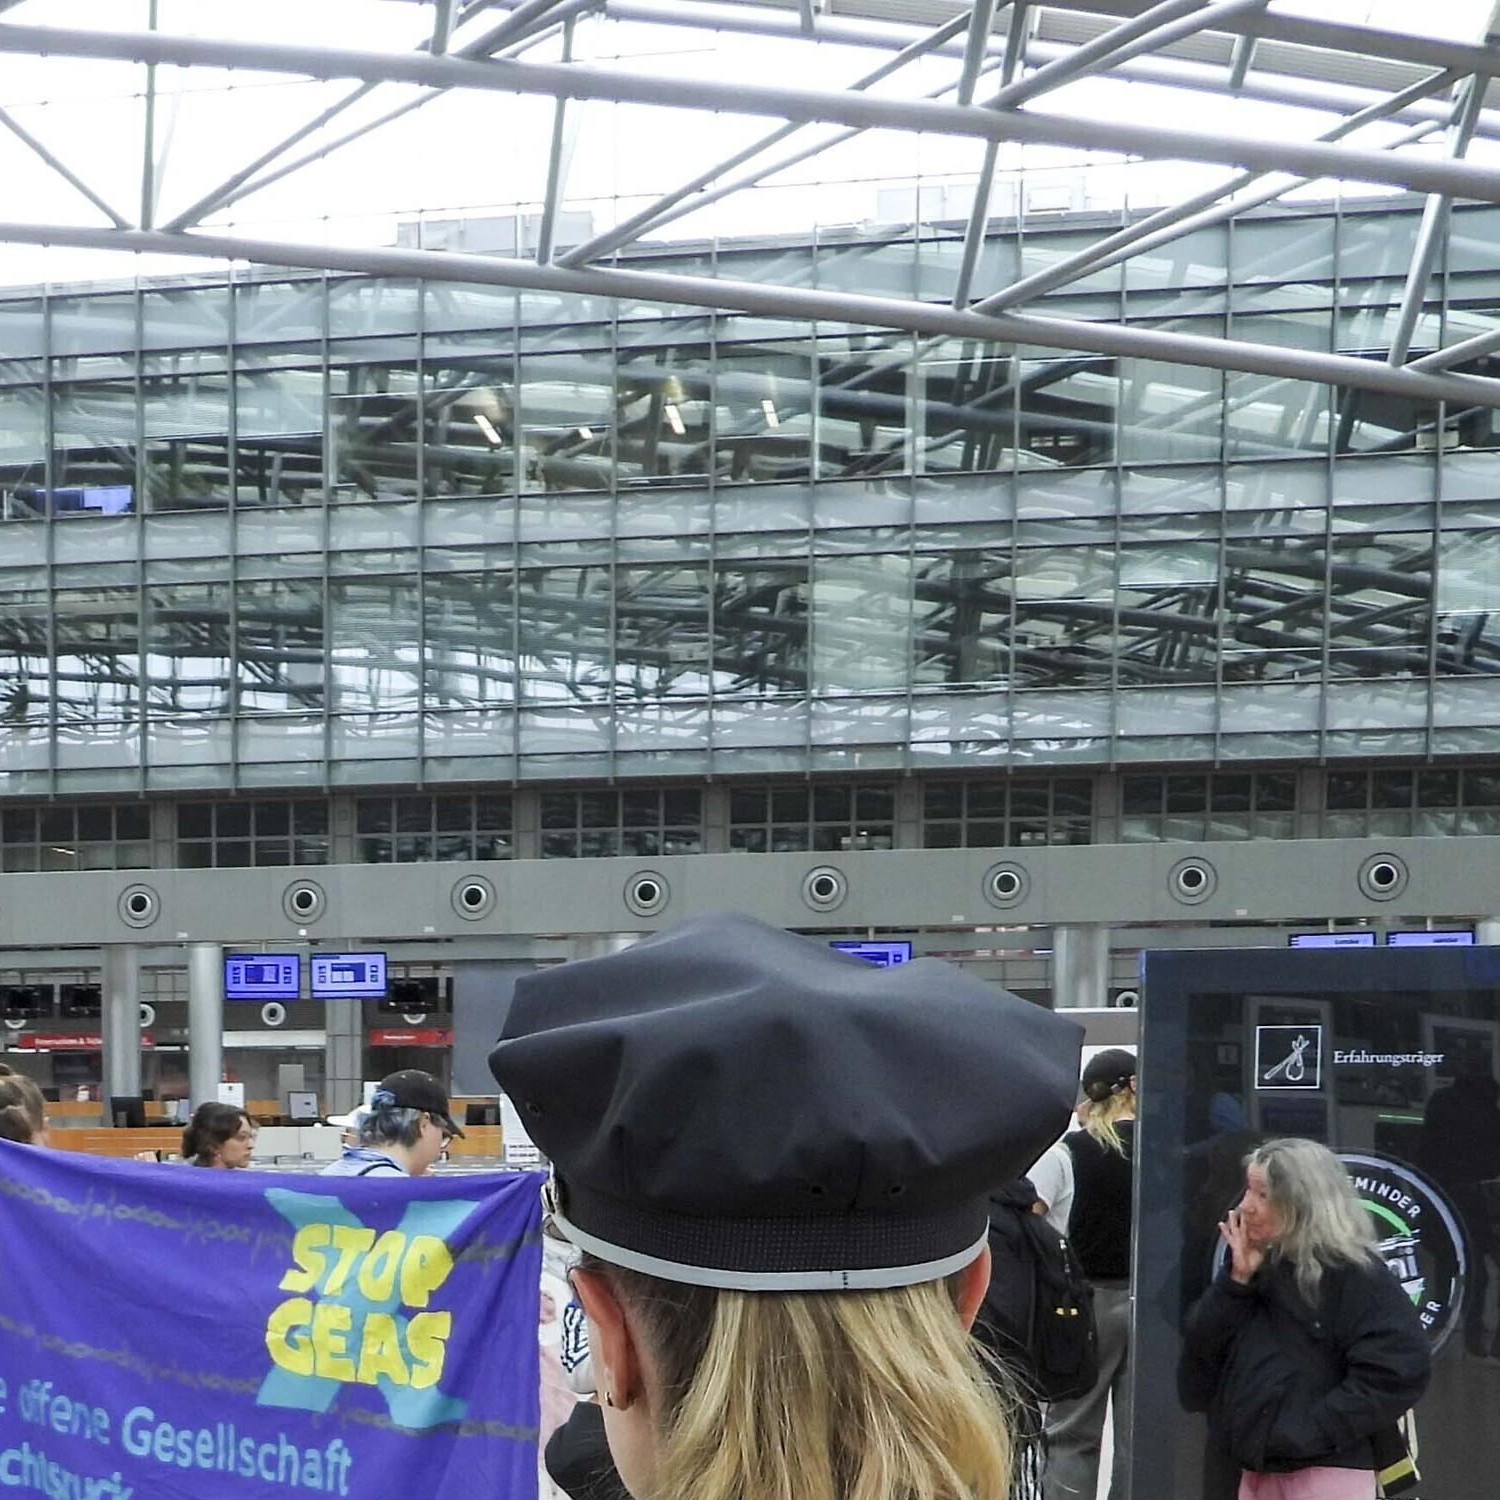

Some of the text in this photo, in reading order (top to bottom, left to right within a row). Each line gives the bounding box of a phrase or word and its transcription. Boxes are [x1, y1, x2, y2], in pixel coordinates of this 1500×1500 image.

[1333, 1049, 1445, 1067] Erfahrungsträger
[1347, 1175, 1421, 1219] MINDER
[278, 1223, 454, 1308] STOP
[265, 1297, 452, 1389] GEAS
[122, 1406, 353, 1497] Gesellschaft
